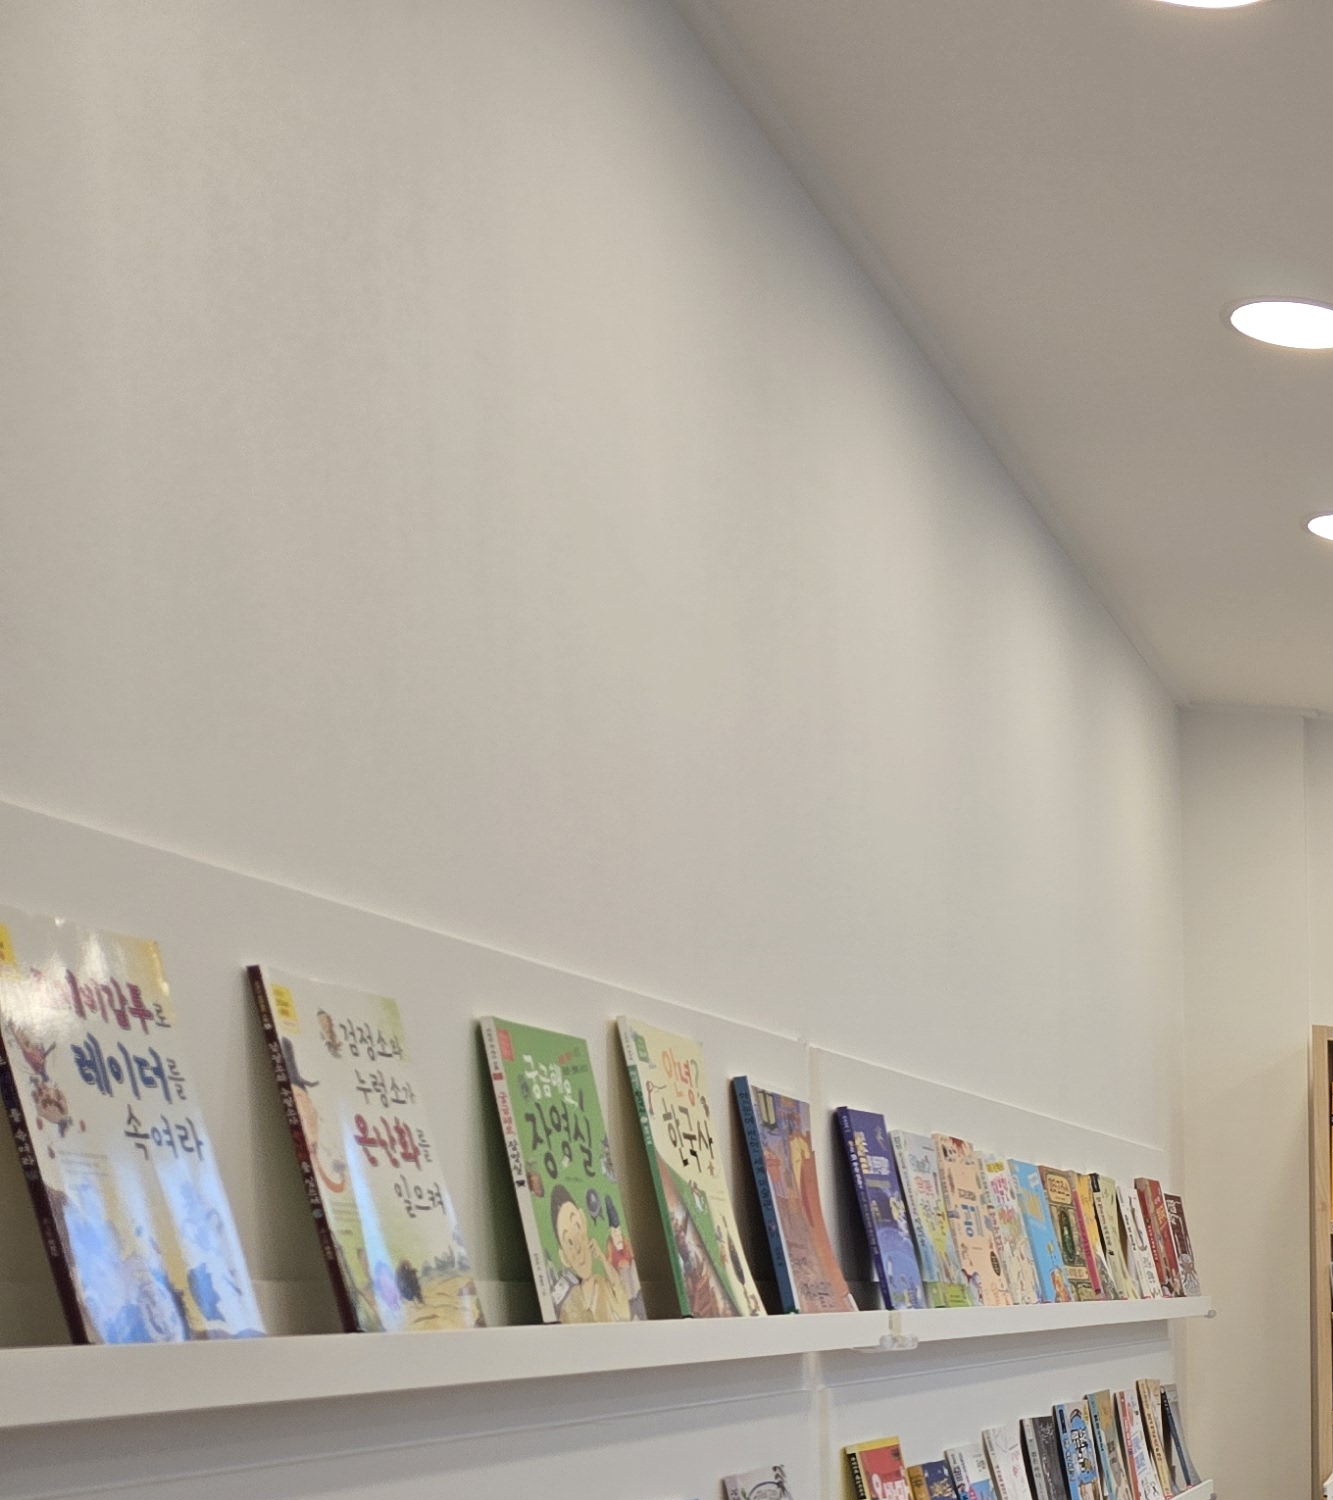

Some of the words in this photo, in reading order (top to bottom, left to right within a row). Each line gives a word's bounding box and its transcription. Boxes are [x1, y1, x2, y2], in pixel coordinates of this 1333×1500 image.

[339, 1018, 403, 1061] 검정소와
[71, 1032, 187, 1104] 레이더를
[355, 1069, 415, 1107] 누렁소가
[522, 1054, 579, 1107] 궁금해요
[124, 1104, 203, 1160] 속여라
[355, 1114, 433, 1171] 온난화를
[525, 1100, 596, 1180] 장영실
[662, 1098, 714, 1173] 한국사
